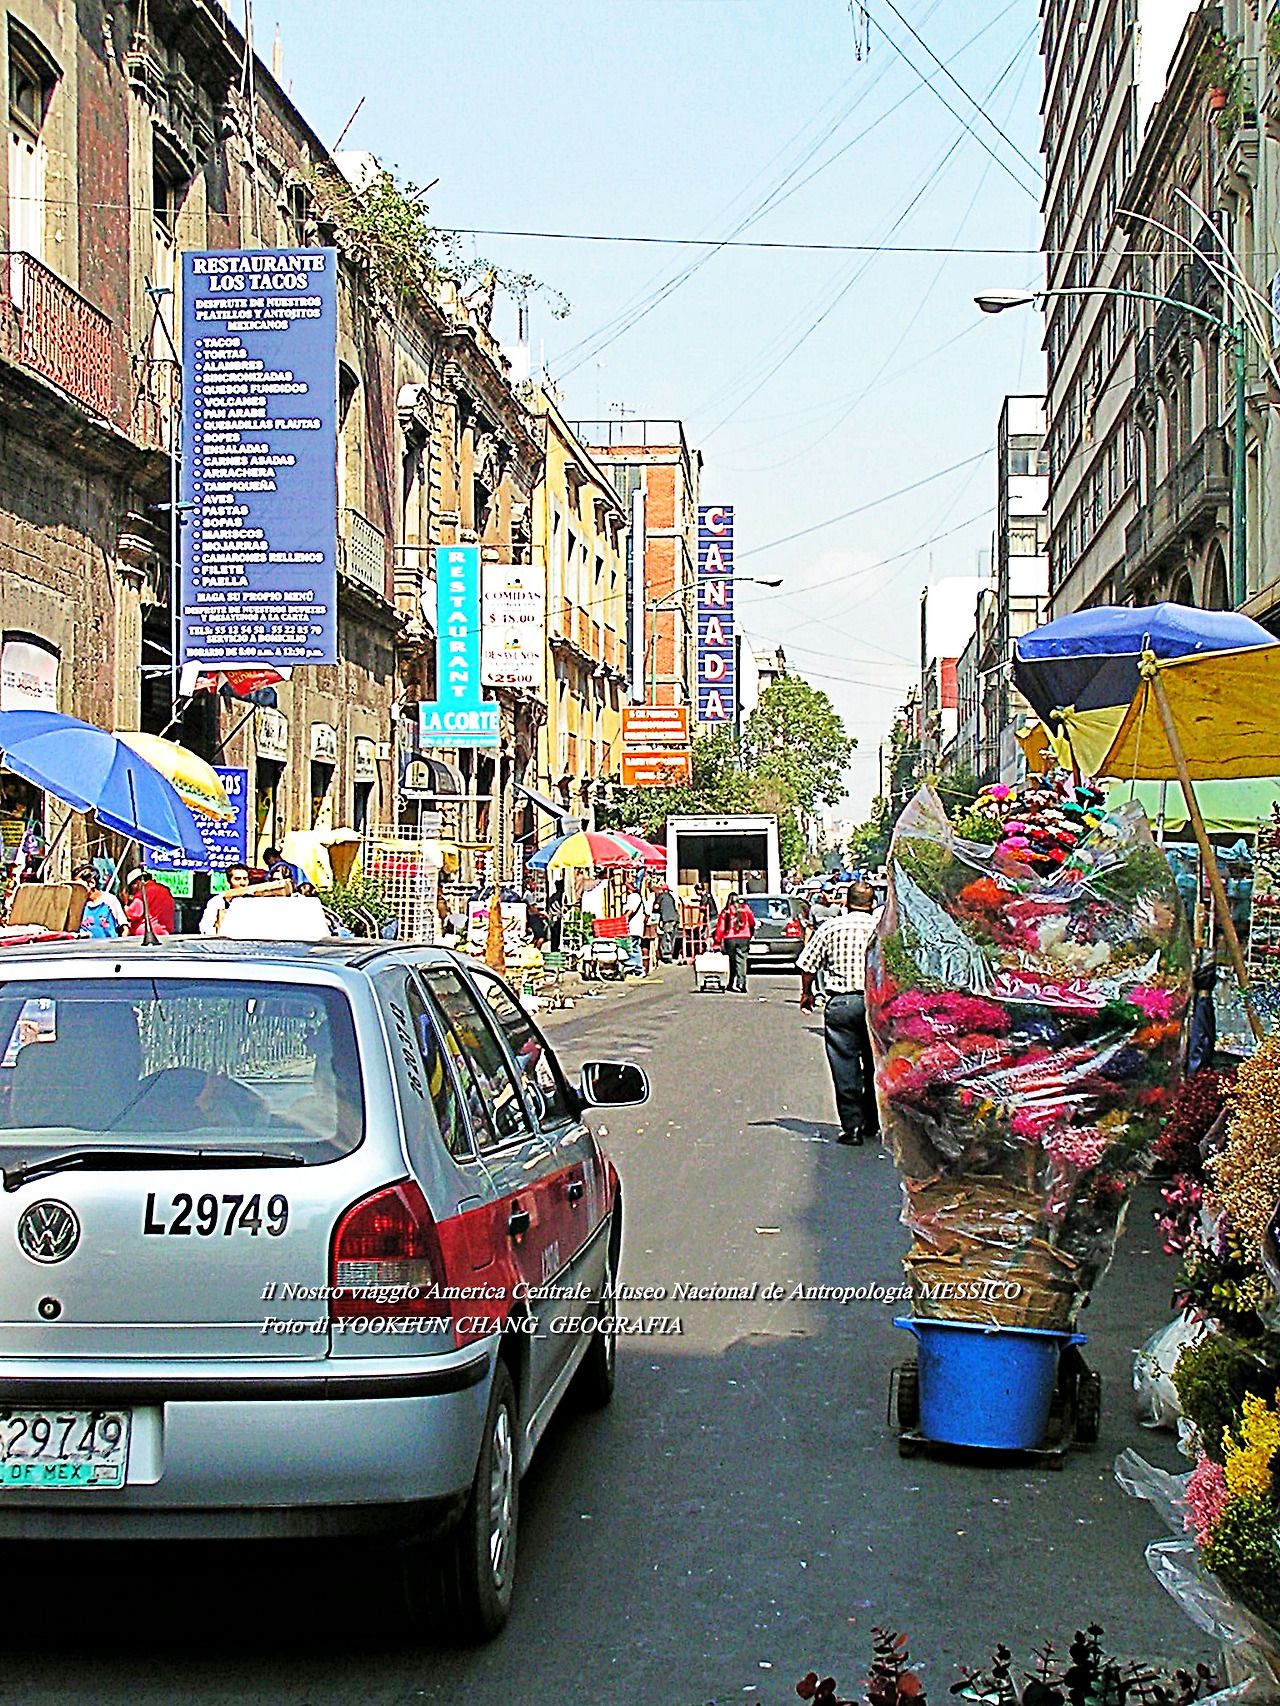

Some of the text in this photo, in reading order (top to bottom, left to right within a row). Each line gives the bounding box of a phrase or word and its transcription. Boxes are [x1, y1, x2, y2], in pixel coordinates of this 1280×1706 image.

[193, 255, 325, 274] RESTAURANTE
[210, 274, 307, 291] LOS TACOS
[195, 296, 321, 309] DISFRUTE DE NUESTROS
[196, 308, 321, 320] PLATILLOS Y ANTOJITOS
[227, 320, 288, 330] MEXICANOS
[203, 337, 241, 348] TACOS
[203, 349, 247, 360] TORTAS
[203, 360, 263, 371] ALAMBRES
[203, 371, 293, 383] SINCRONIZADAS
[202, 383, 307, 395] QUESOS FUNDIDOS
[203, 396, 267, 407] VOLCANES
[203, 408, 266, 419] PAN ARABE
[203, 418, 321, 431] QUESADILLAS FLAUTAS
[203, 432, 241, 443] SOPES
[203, 443, 269, 455] ENSALADAS
[203, 455, 295, 466] CARNES ASADAS
[202, 467, 276, 478] ARRACHERA
[202, 479, 277, 492] TAMPIQUEÑA
[202, 494, 234, 505] AVES
[202, 505, 249, 516] PASTAS
[202, 517, 243, 528] SOPAS
[202, 528, 264, 540] MARISCOS
[202, 540, 268, 552] MOJARRAS
[202, 552, 324, 564] CAMARONES RELLENOS
[201, 565, 244, 575] FILETE
[202, 576, 248, 587] PAELLA
[197, 590, 313, 602] HAGA SU PROPIO MENÚ
[485, 592, 540, 600] COMIDAS
[184, 606, 227, 615] DISFRUTE
[228, 606, 241, 614] DE
[704, 507, 727, 720] CANADA
[201, 614, 208, 622] Y
[208, 614, 259, 622] DESAYUNOS
[268, 613, 280, 621] LA
[280, 613, 310, 621] CARTA
[448, 552, 469, 697] RESTAURANT
[206, 634, 307, 643] SERVICIO A DOMICILIO
[186, 648, 225, 657] HORARIO
[225, 648, 238, 656] DE
[275, 648, 282, 656] A
[485, 651, 539, 659] DESAYUNOS
[422, 711, 498, 730] LA CORTE
[201, 829, 239, 838] CARTA
[144, 1193, 289, 1236] L29749
[11, 1464, 81, 1480] OF MEX
